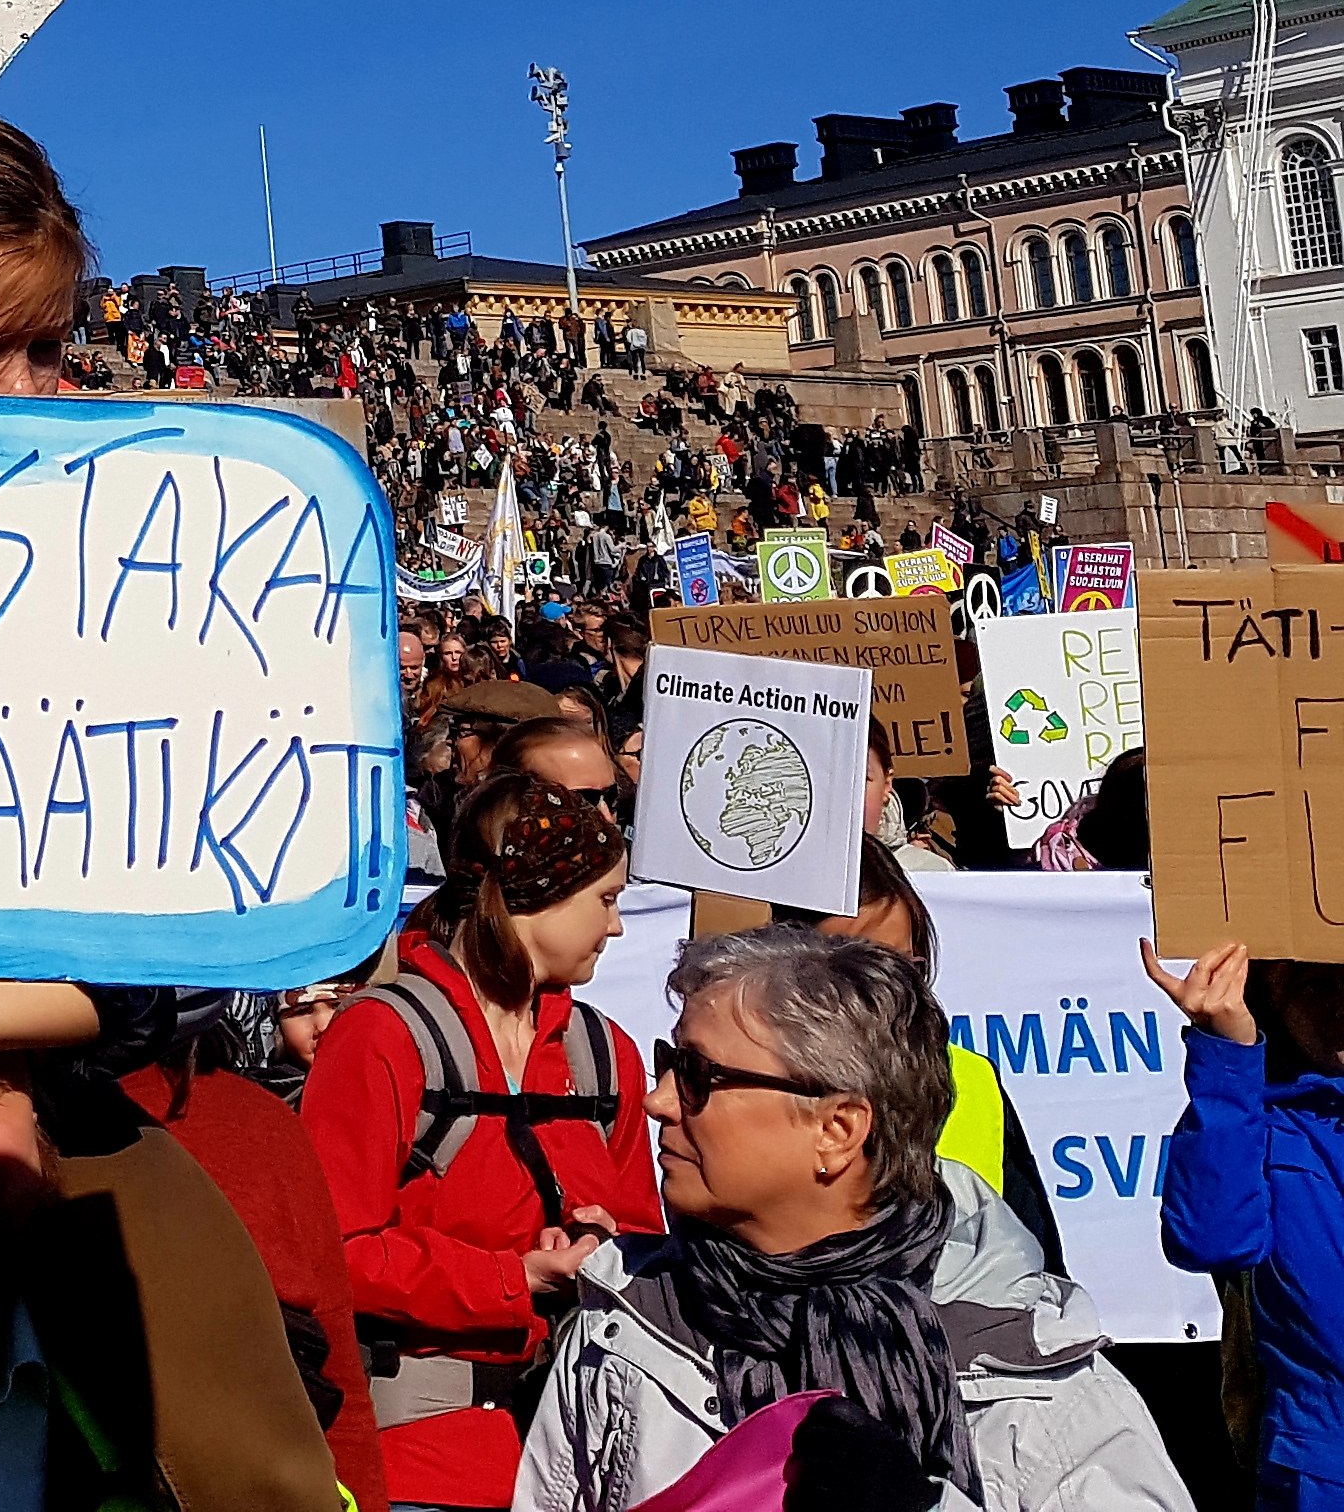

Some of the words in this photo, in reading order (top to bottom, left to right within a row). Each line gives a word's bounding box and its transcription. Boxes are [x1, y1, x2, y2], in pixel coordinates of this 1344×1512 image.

[1078, 552, 1124, 565] ASERAHAT
[1075, 564, 1122, 577] ILMASTON
[1069, 576, 1124, 589] SUOJELUUN
[666, 615, 761, 646] TURVE
[765, 613, 841, 636] KUULUU
[656, 673, 734, 704] Climate
[739, 684, 807, 714] Action
[813, 694, 860, 720] Now
